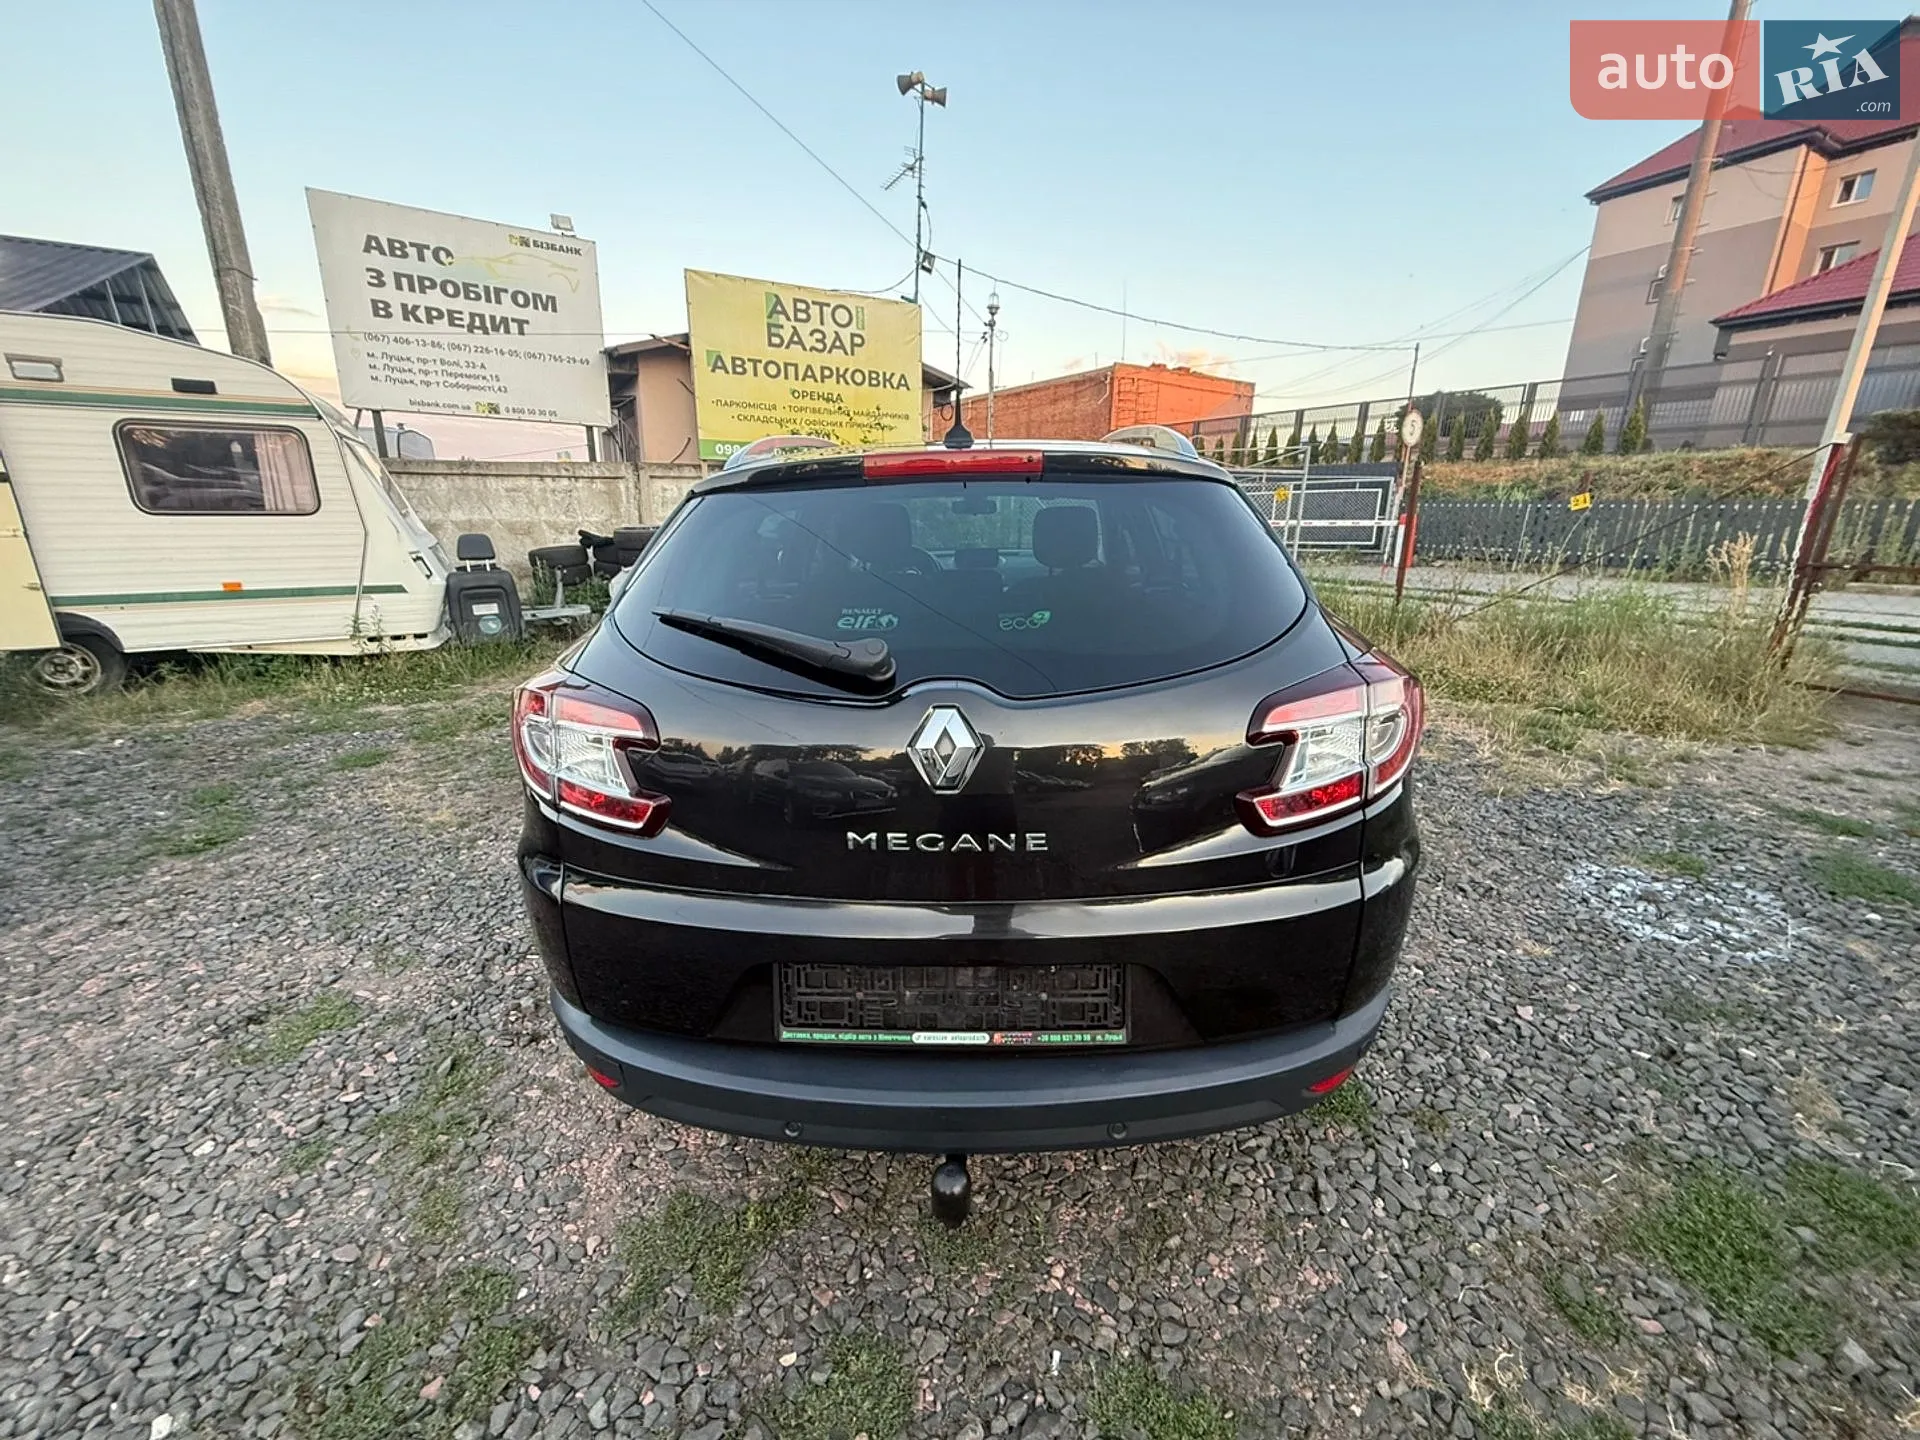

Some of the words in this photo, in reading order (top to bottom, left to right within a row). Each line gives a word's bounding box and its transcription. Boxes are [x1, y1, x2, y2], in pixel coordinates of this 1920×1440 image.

[362, 234, 455, 266] АВТО
[532, 239, 583, 256] БІЗБАНК
[365, 267, 386, 288] З
[393, 271, 558, 313] ПРОБІГОМ
[370, 298, 393, 320] В
[401, 302, 530, 336] КРЕДИТ
[767, 293, 854, 329] АВТО
[364, 332, 390, 345] (067)
[447, 342, 472, 353] (067)
[523, 351, 546, 362] (067)
[766, 322, 865, 357] БАЗАР
[366, 351, 379, 359] м.
[381, 351, 414, 364] Луцьк,
[416, 356, 438, 365] пр-т
[440, 358, 463, 369] Волі,
[368, 363, 380, 371] м.
[383, 363, 416, 375] Луцьк,
[418, 368, 439, 377] пр-т
[710, 353, 911, 391] АВТОПАРКОВКА
[384, 375, 418, 387] Луцьк,
[419, 380, 440, 388] пр-т
[409, 398, 471, 411] bisbank.com.ua
[791, 389, 843, 403] ОРЕНДА
[715, 399, 777, 412] ПАРКОМІСЦЯ
[736, 413, 797, 426] СКЛАДСЬКИХ
[1409, 419, 1417, 436] 5
[837, 615, 876, 629] elf
[846, 831, 1049, 852] MEGANE
